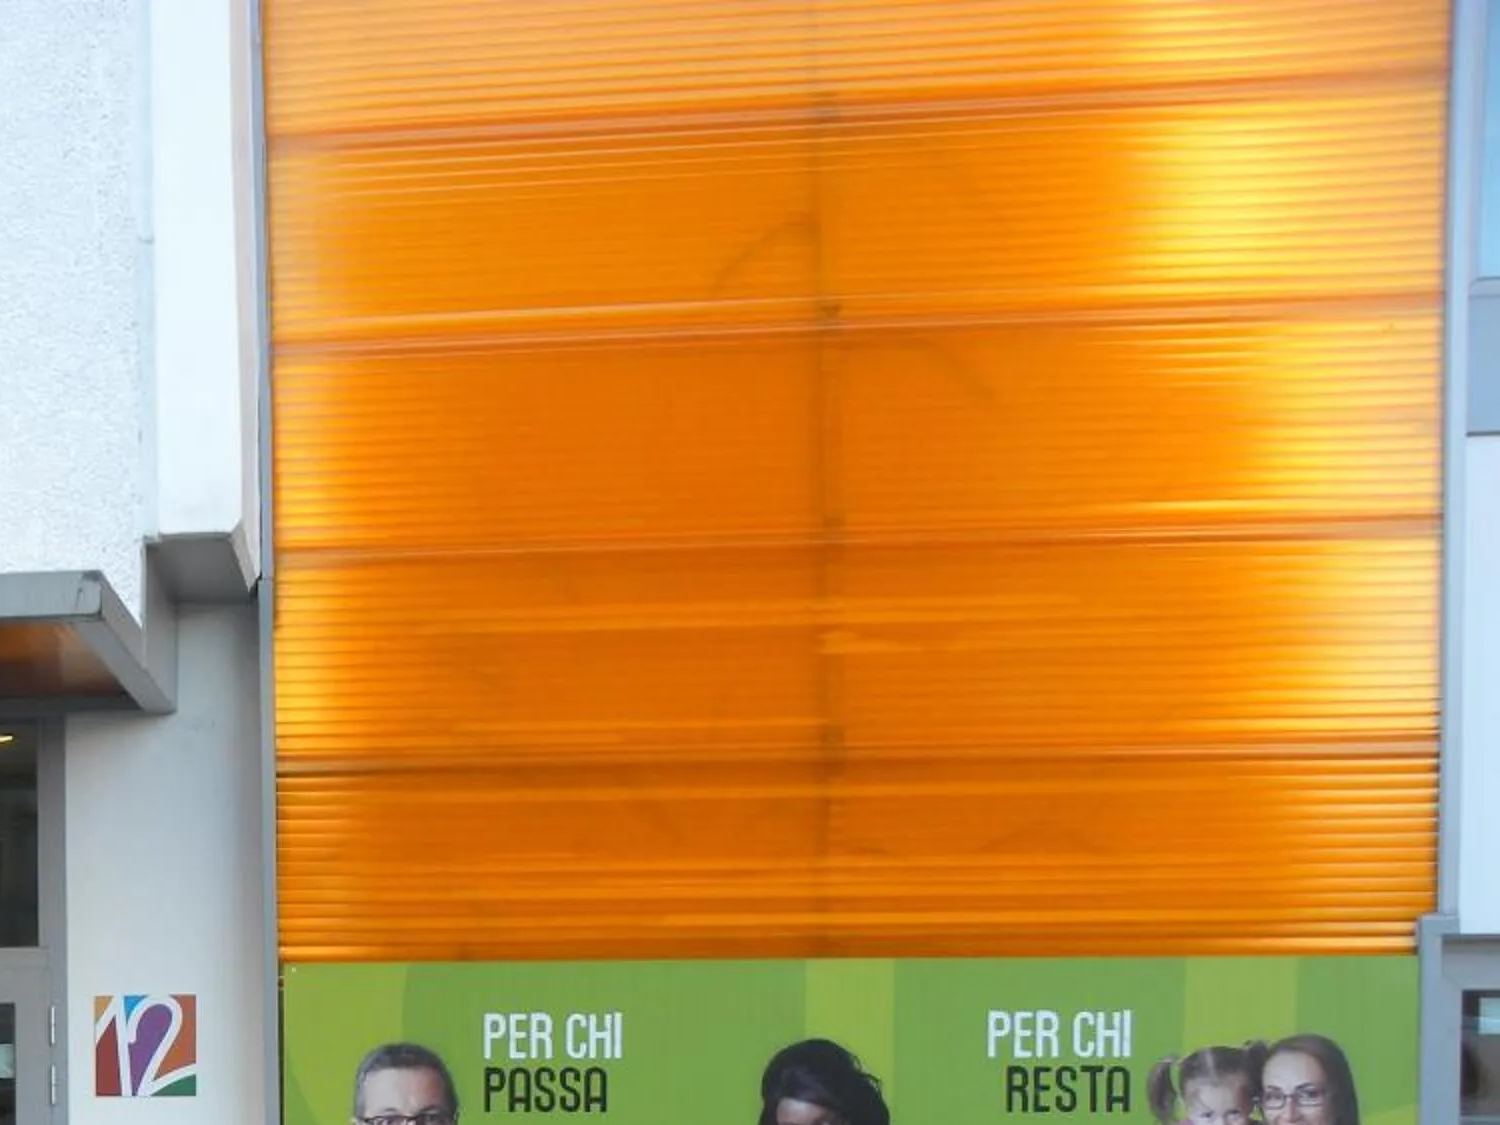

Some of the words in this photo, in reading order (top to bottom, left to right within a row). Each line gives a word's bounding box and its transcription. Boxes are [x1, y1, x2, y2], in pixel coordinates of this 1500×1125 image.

[94, 993, 197, 1097] 12
[483, 1012, 554, 1060] PER
[565, 1012, 623, 1060] CHI
[987, 1010, 1060, 1058] PER
[1072, 1010, 1133, 1058] CHI
[483, 1066, 608, 1113] PASSA
[1006, 1065, 1131, 1113] RESTA
